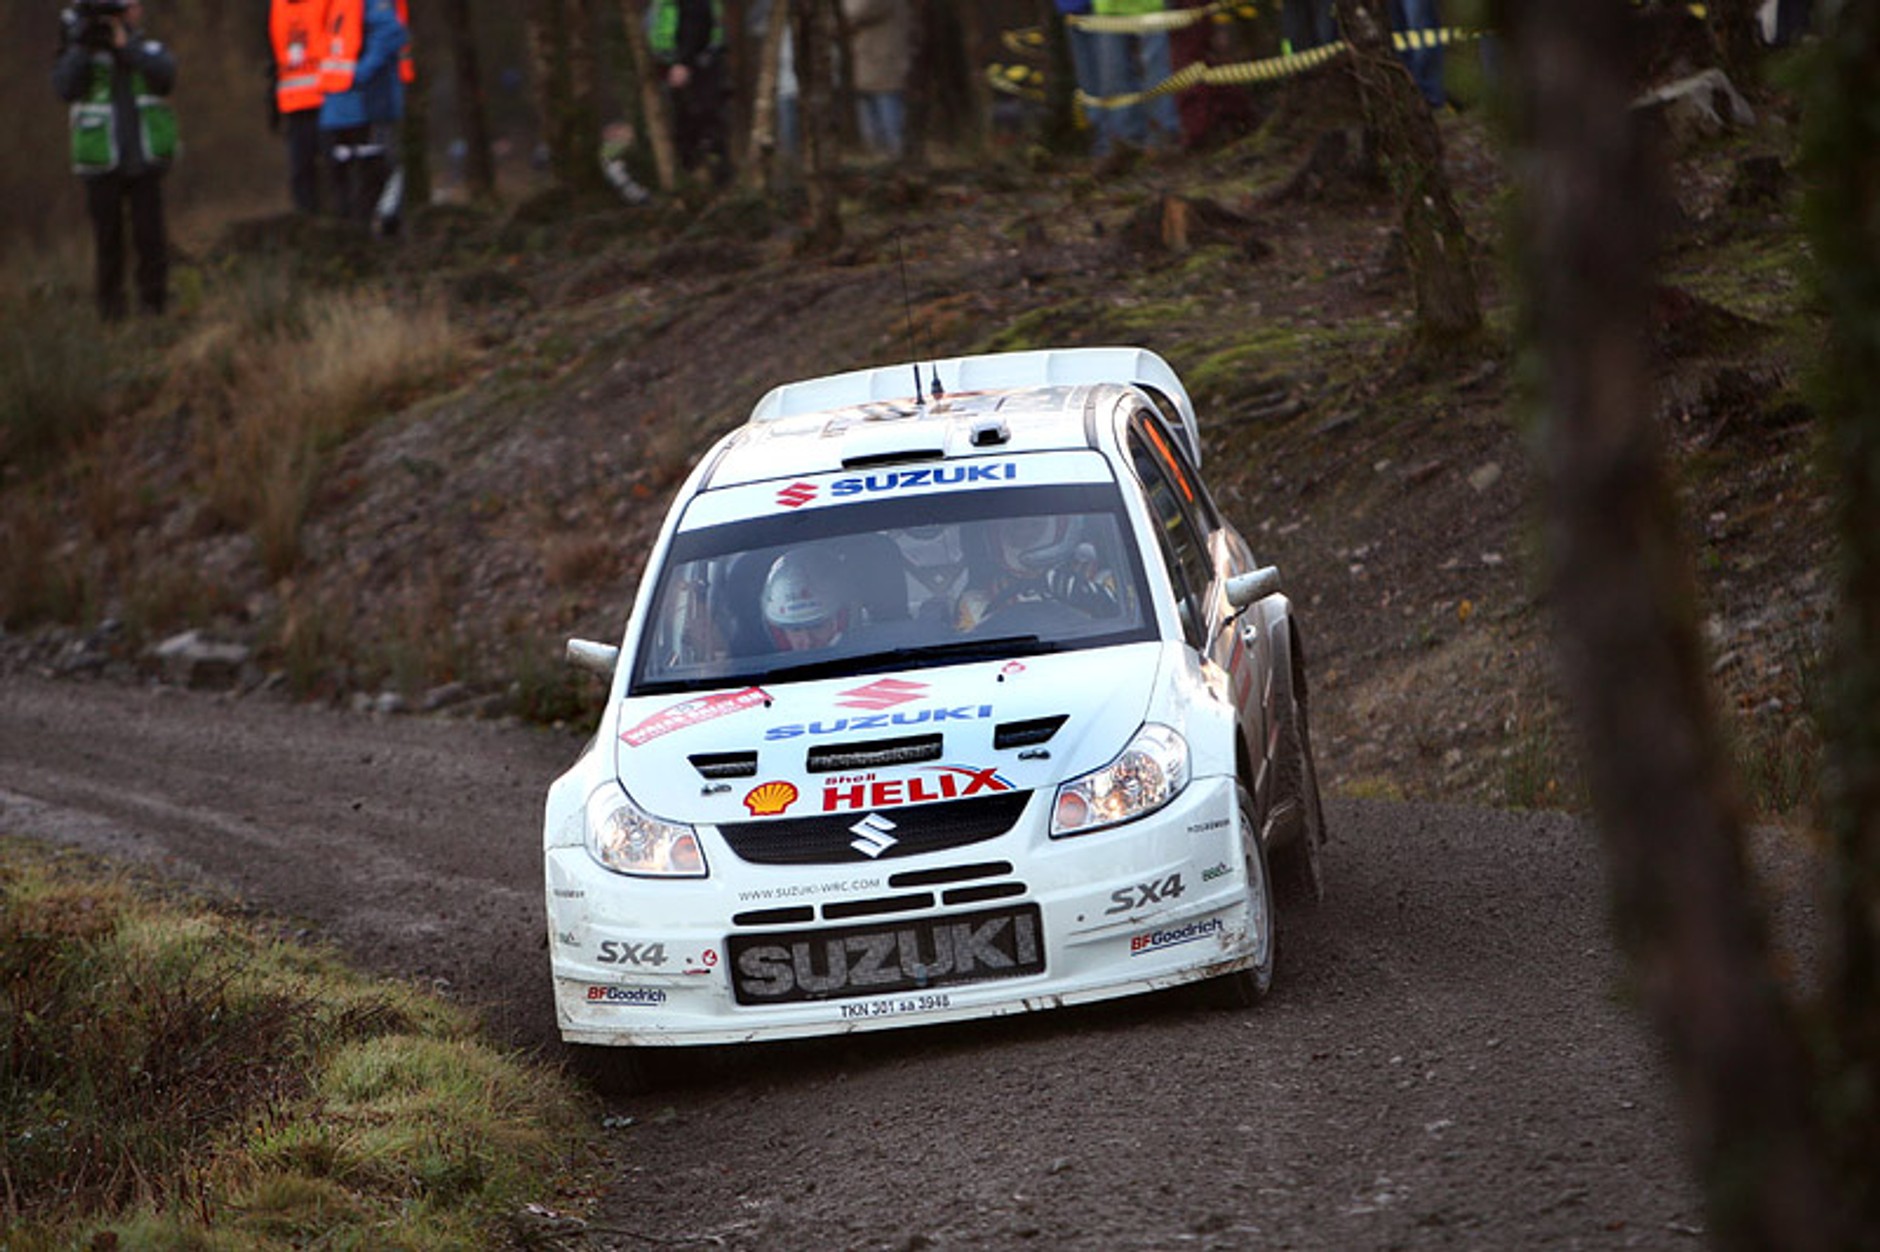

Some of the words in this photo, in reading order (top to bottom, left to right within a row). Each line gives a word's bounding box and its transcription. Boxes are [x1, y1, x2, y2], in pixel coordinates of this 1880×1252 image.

[831, 463, 1016, 497] SUZUKI
[764, 705, 992, 740] SUZUKI
[823, 768, 1009, 811] HELIX
[825, 773, 876, 785] Shell
[1105, 873, 1185, 915] SX4
[1130, 918, 1224, 951] BFGoodrich
[597, 940, 668, 966] SX4
[738, 913, 1038, 996] SUZUKI
[587, 986, 667, 1002] BFGoodrich
[840, 1003, 868, 1018] TKN
